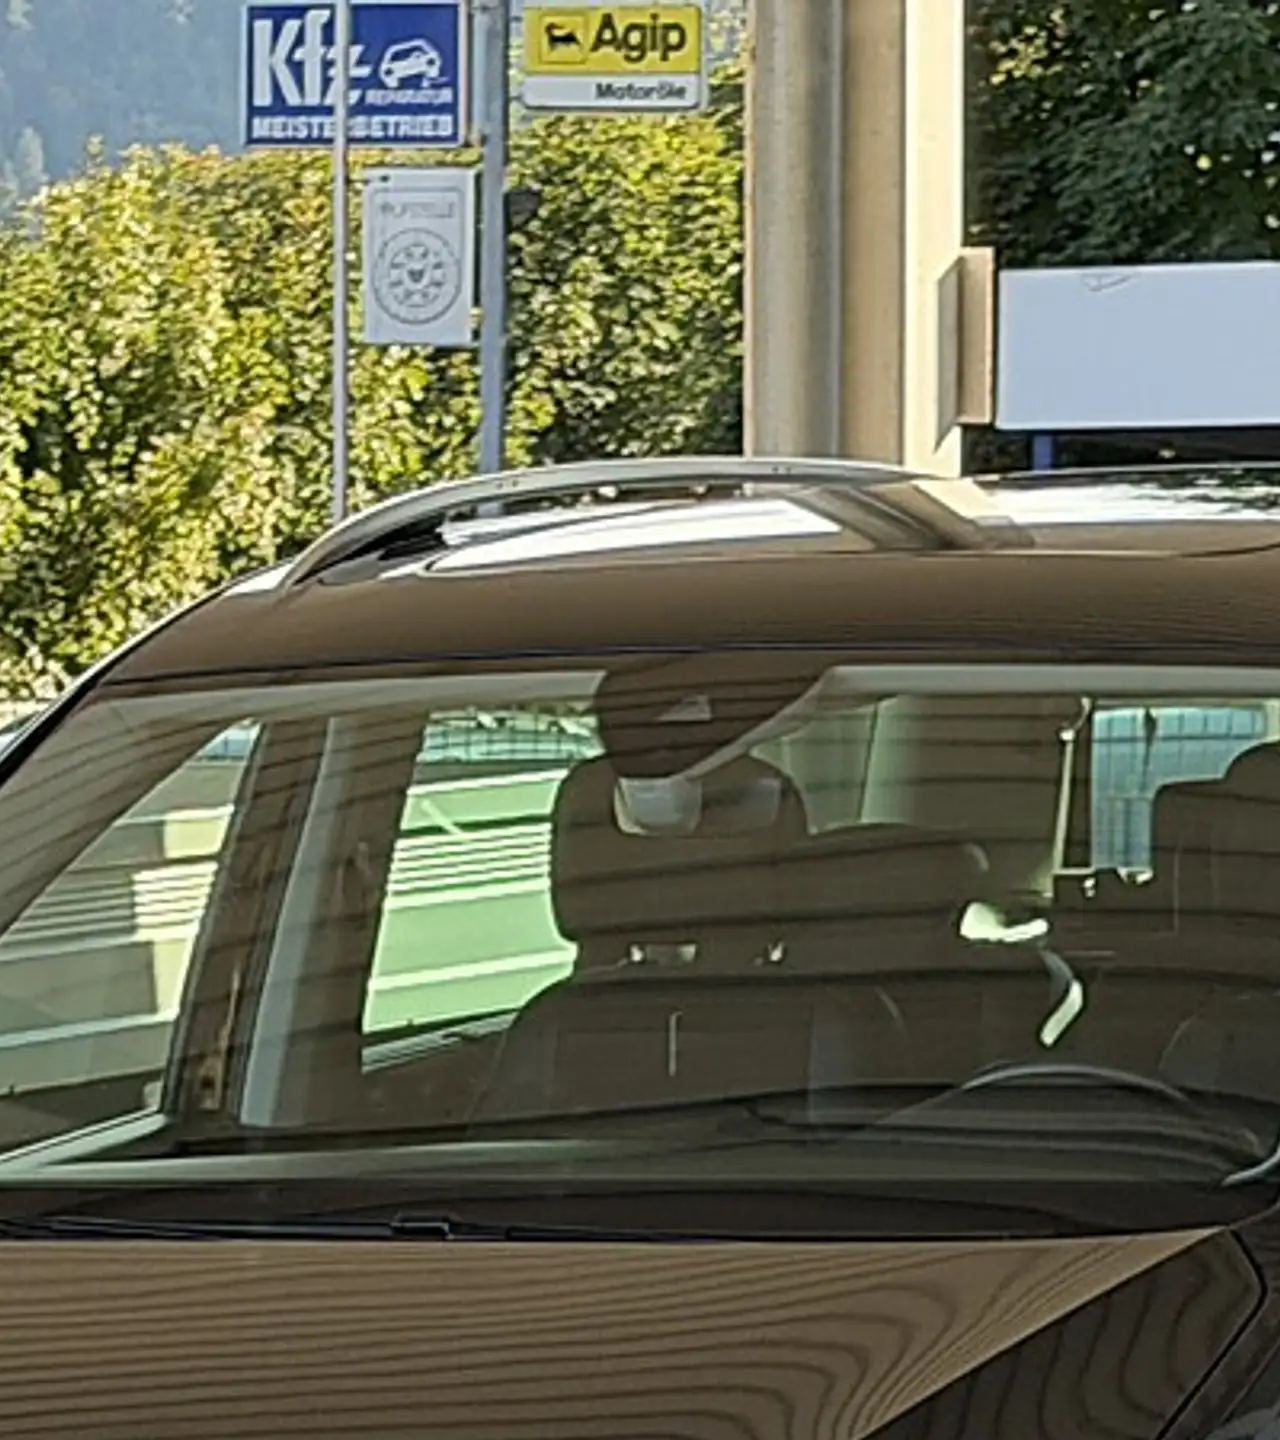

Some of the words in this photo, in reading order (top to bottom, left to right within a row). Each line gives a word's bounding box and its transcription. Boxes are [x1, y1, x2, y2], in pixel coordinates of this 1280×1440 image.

[253, 9, 372, 107] Kfz
[589, 13, 687, 63] Agip
[253, 115, 452, 138] MEISTEBETRIEB
